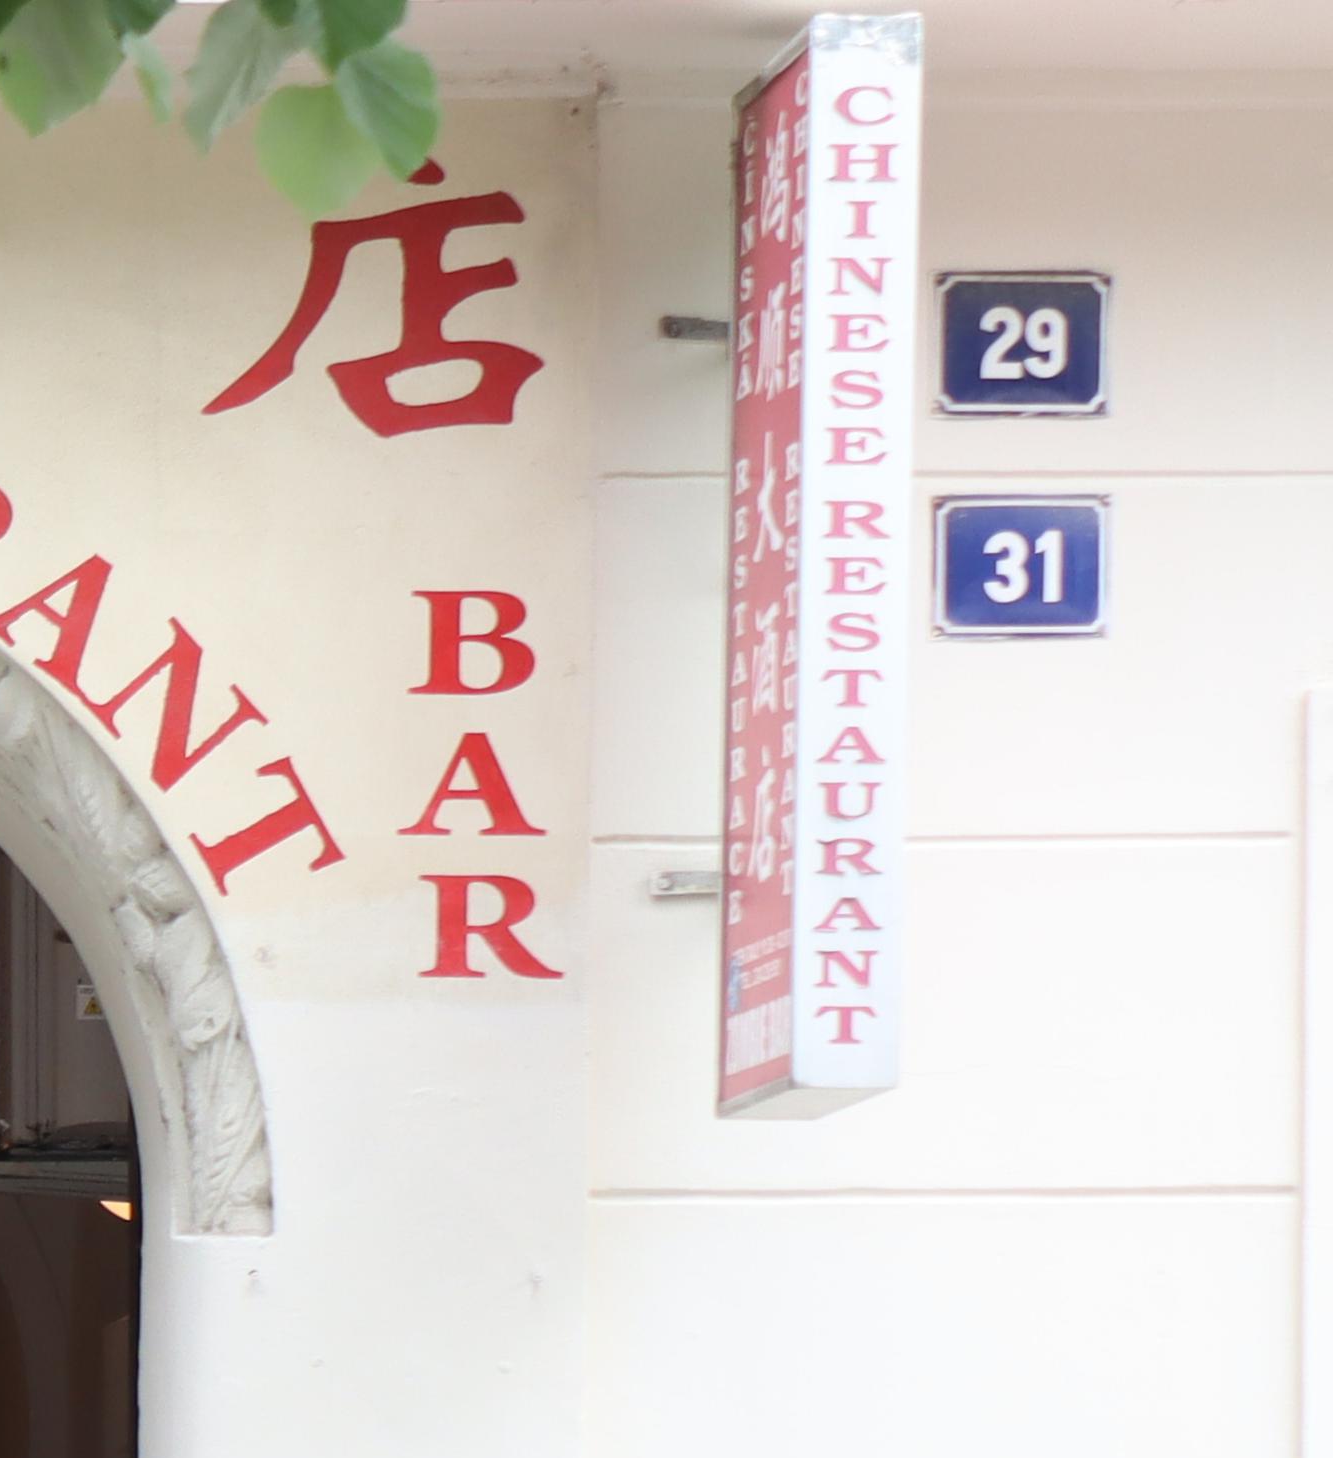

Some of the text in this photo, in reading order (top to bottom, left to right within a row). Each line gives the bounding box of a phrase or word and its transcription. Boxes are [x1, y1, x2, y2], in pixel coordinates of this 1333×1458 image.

[979, 306, 1068, 379] 29
[727, 457, 751, 926] RESTAURACE
[780, 441, 801, 896] RESTAURANT
[814, 86, 900, 1045] CHINESE RESTAURANT
[982, 530, 1063, 604] 31
[397, 589, 565, 979] BAR
